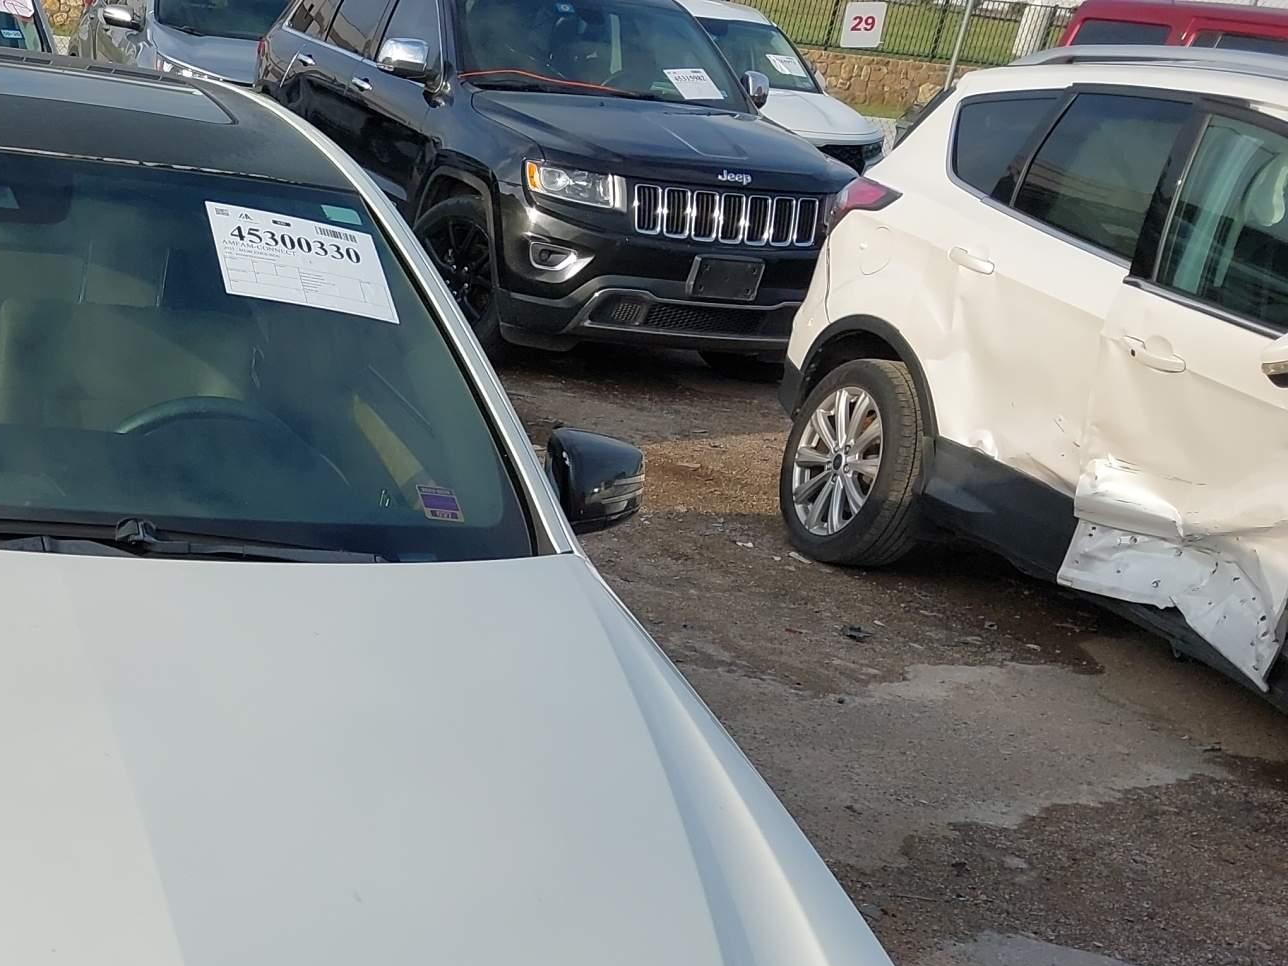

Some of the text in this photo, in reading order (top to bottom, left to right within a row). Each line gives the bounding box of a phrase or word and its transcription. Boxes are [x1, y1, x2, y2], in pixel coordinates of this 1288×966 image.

[850, 15, 876, 32] 29
[717, 169, 752, 186] Jeep
[230, 225, 361, 265] 45300330
